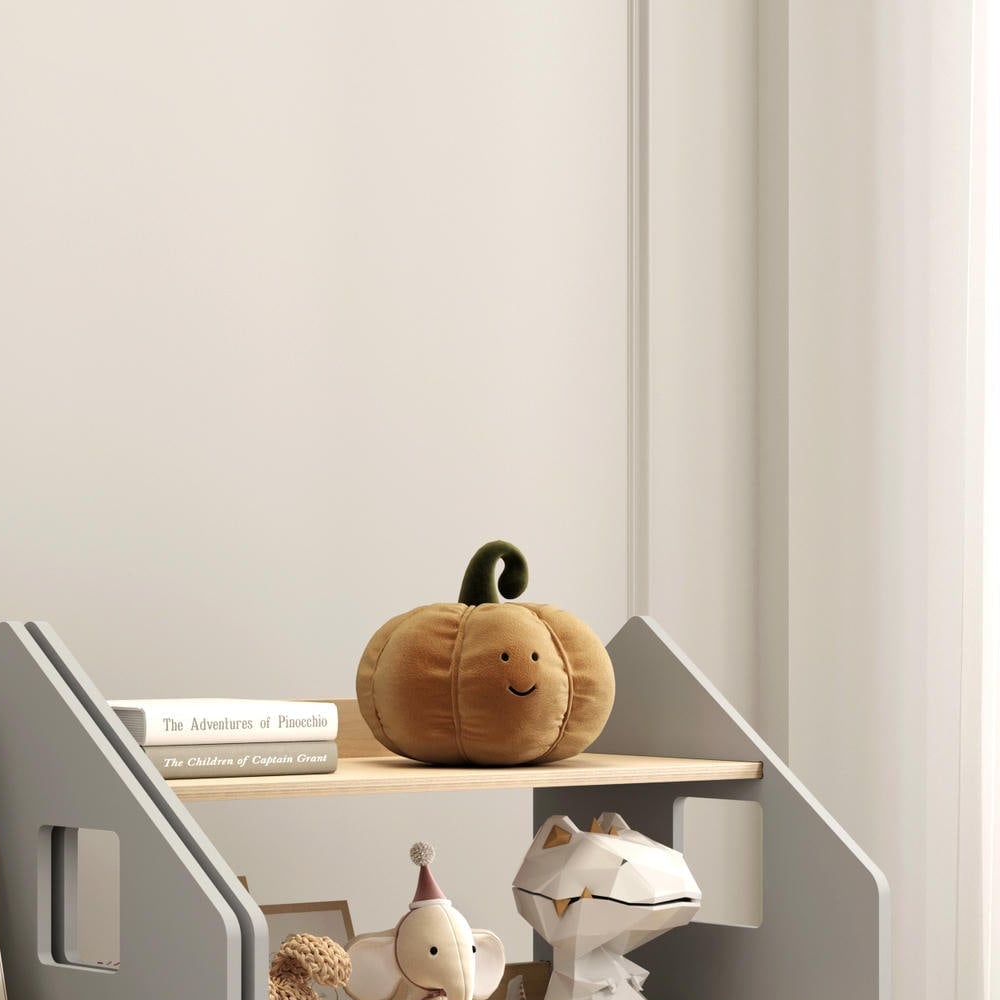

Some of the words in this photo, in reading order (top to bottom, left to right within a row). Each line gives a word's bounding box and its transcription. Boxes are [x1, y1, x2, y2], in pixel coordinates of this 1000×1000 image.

[163, 717, 184, 732] The
[190, 716, 253, 731] Adventures
[260, 716, 271, 729] of
[278, 714, 328, 729] Pinocchio
[163, 758, 184, 768] The
[187, 755, 234, 767] Children
[236, 755, 250, 767] of
[252, 754, 293, 767] Captain
[296, 753, 328, 763] Grant
